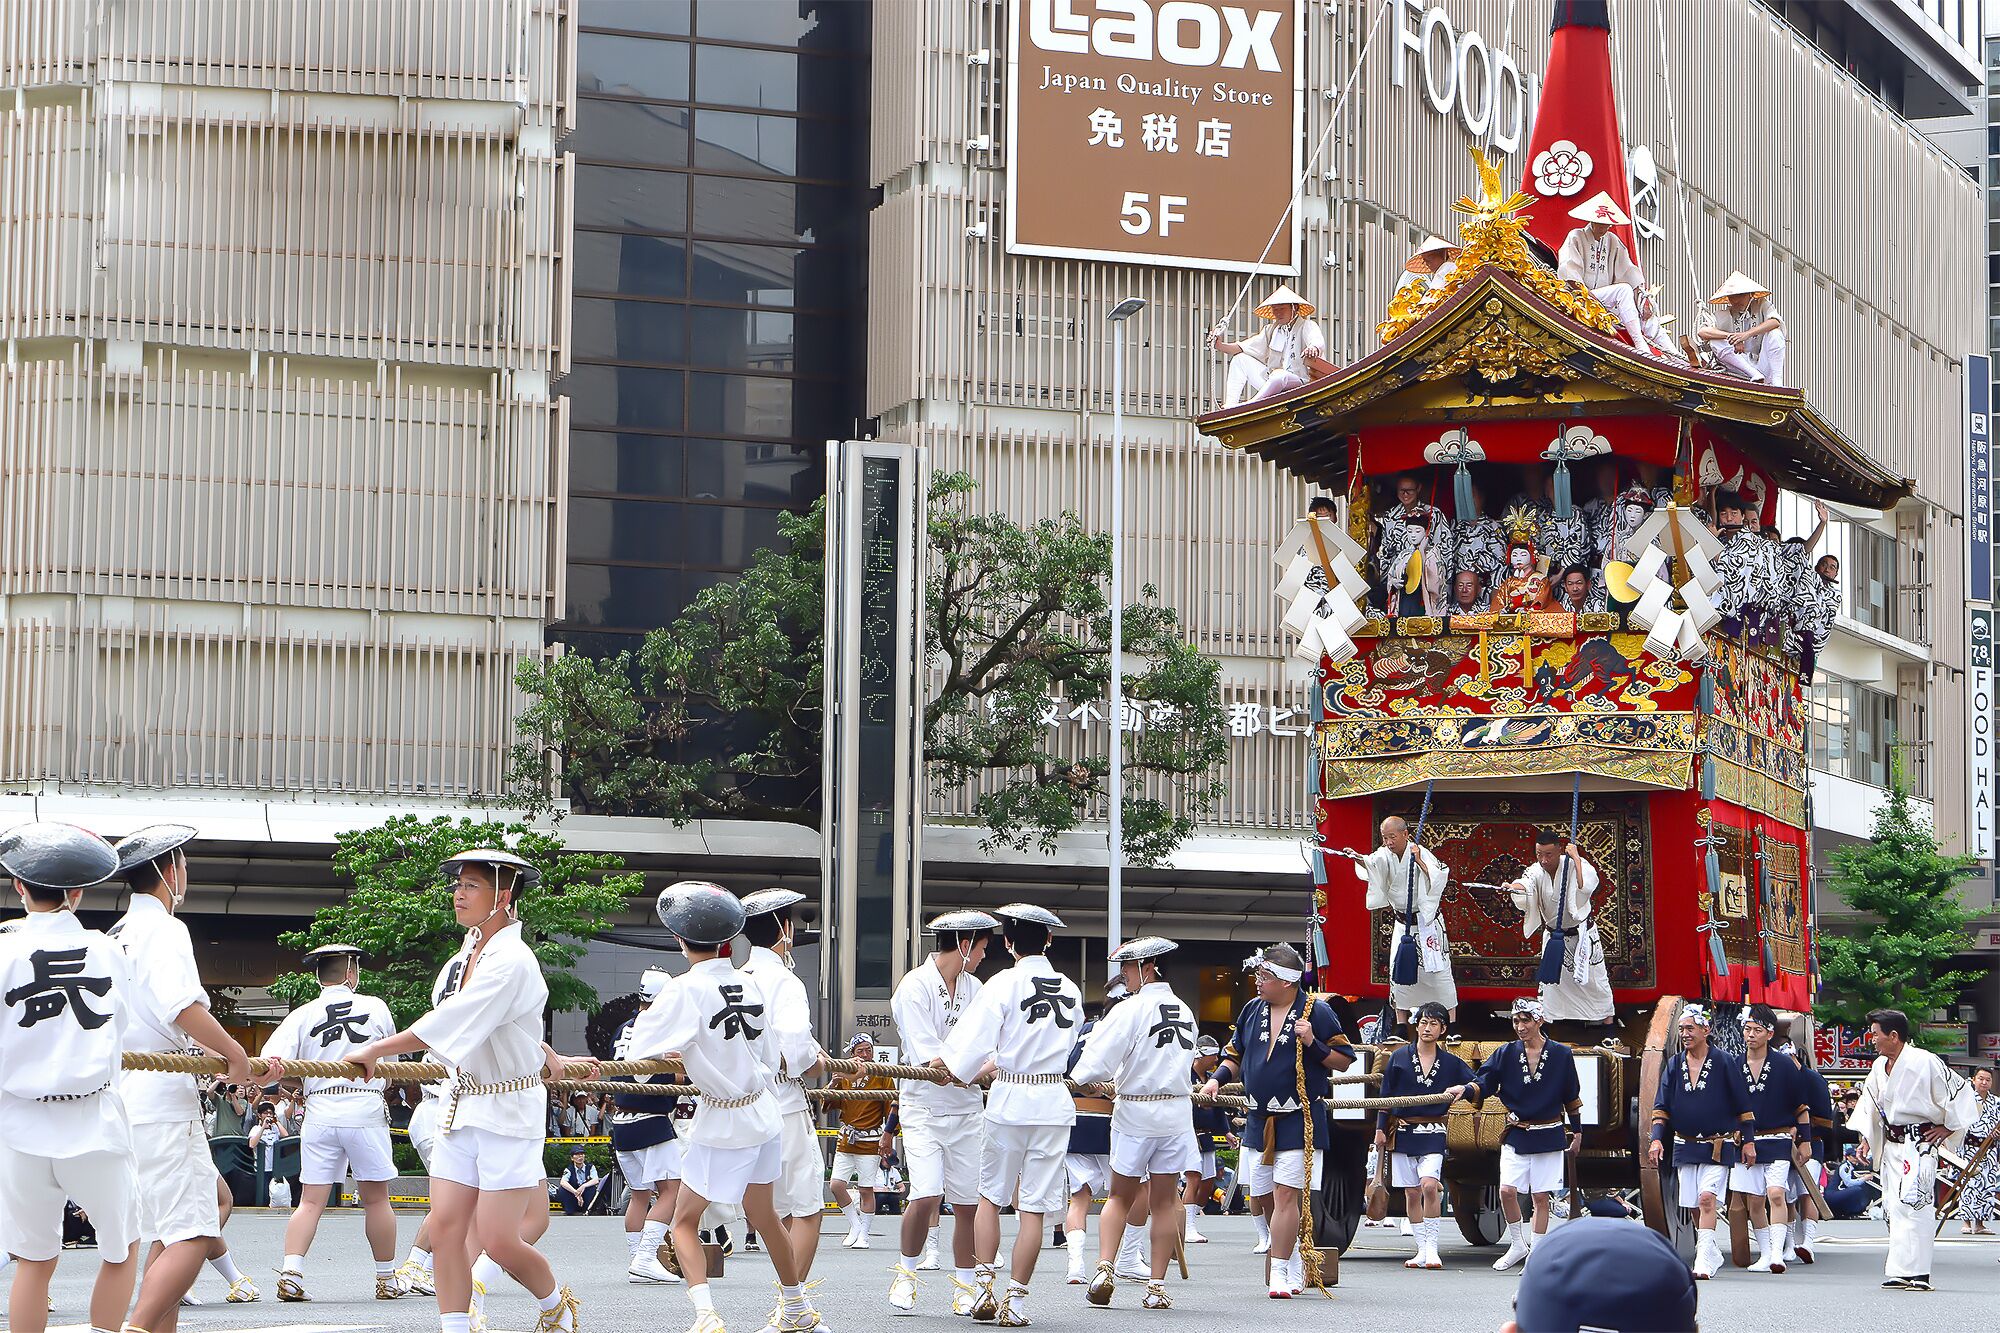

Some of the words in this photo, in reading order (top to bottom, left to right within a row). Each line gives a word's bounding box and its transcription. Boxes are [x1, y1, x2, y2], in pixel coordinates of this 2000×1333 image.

[1029, 0, 1283, 73] Laox
[1039, 65, 1106, 94] Japan
[1116, 73, 1202, 105] Quality
[1213, 81, 1273, 106] Store
[1391, 0, 1523, 154] FOOD
[1087, 106, 1232, 158] 免税店
[1119, 191, 1188, 237] 5F
[1975, 670, 1989, 757] FOOD
[1975, 767, 1989, 852] HALL
[856, 1014, 891, 1027] 京都市
